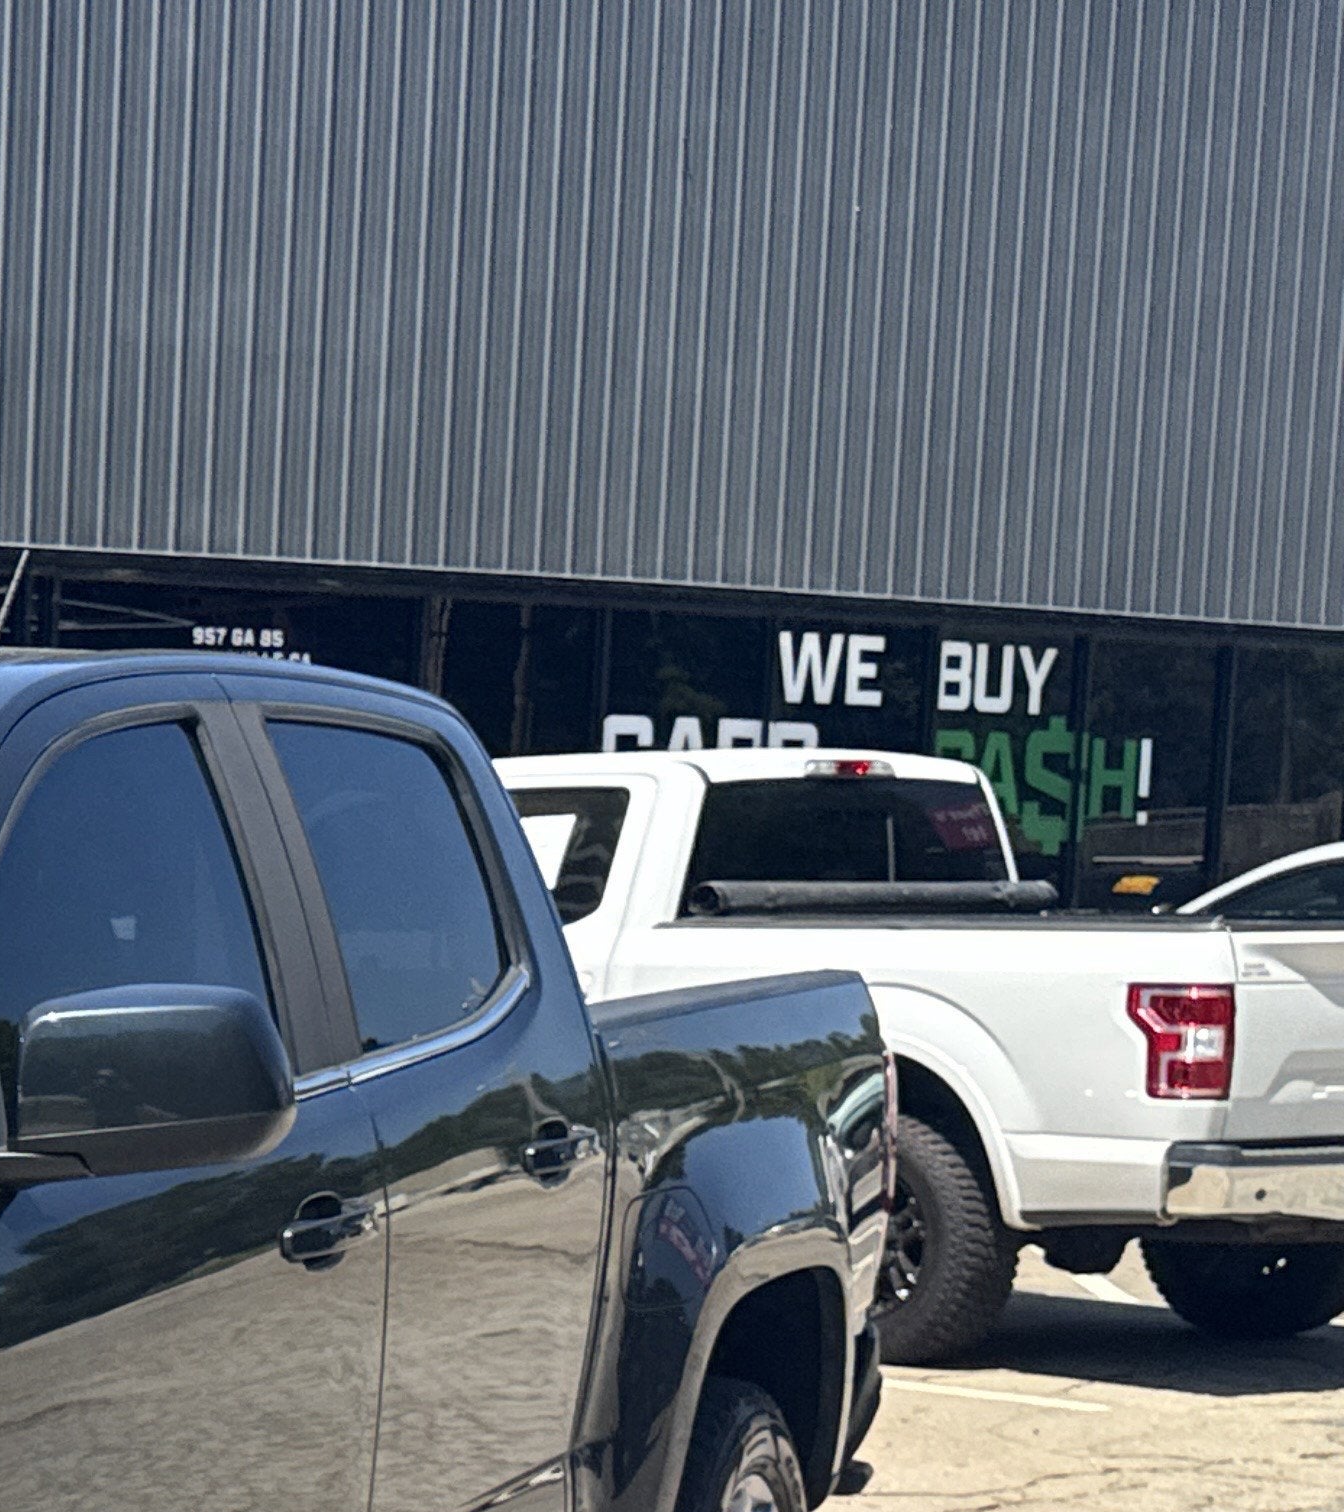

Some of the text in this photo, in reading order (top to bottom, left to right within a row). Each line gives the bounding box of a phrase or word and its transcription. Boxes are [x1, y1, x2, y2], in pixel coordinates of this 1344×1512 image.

[231, 627, 255, 647] GA
[778, 630, 1058, 716] WE BUY
